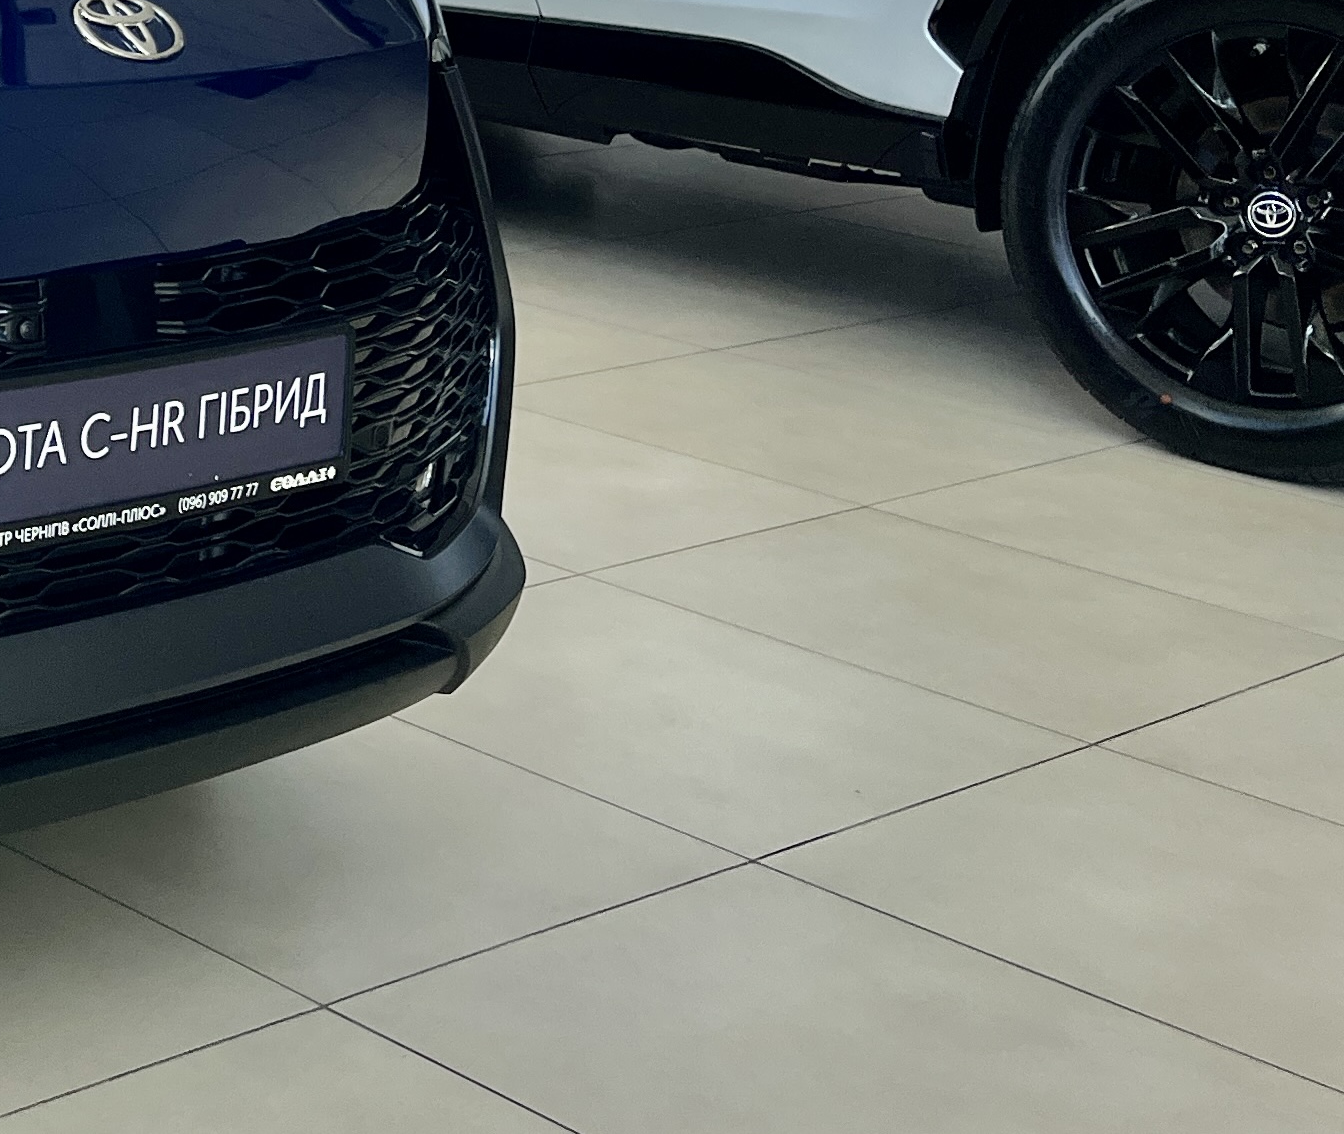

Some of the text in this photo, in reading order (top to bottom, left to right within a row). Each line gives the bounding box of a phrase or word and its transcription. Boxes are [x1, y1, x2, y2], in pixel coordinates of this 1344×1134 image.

[80, 401, 186, 459] C-HR
[197, 372, 327, 440] ГІБРИД
[14, 521, 70, 544] ЧЕРНІГІВ
[178, 493, 207, 514] (096)
[208, 488, 229, 507] 909
[230, 485, 244, 501] 77
[246, 482, 260, 498] 77
